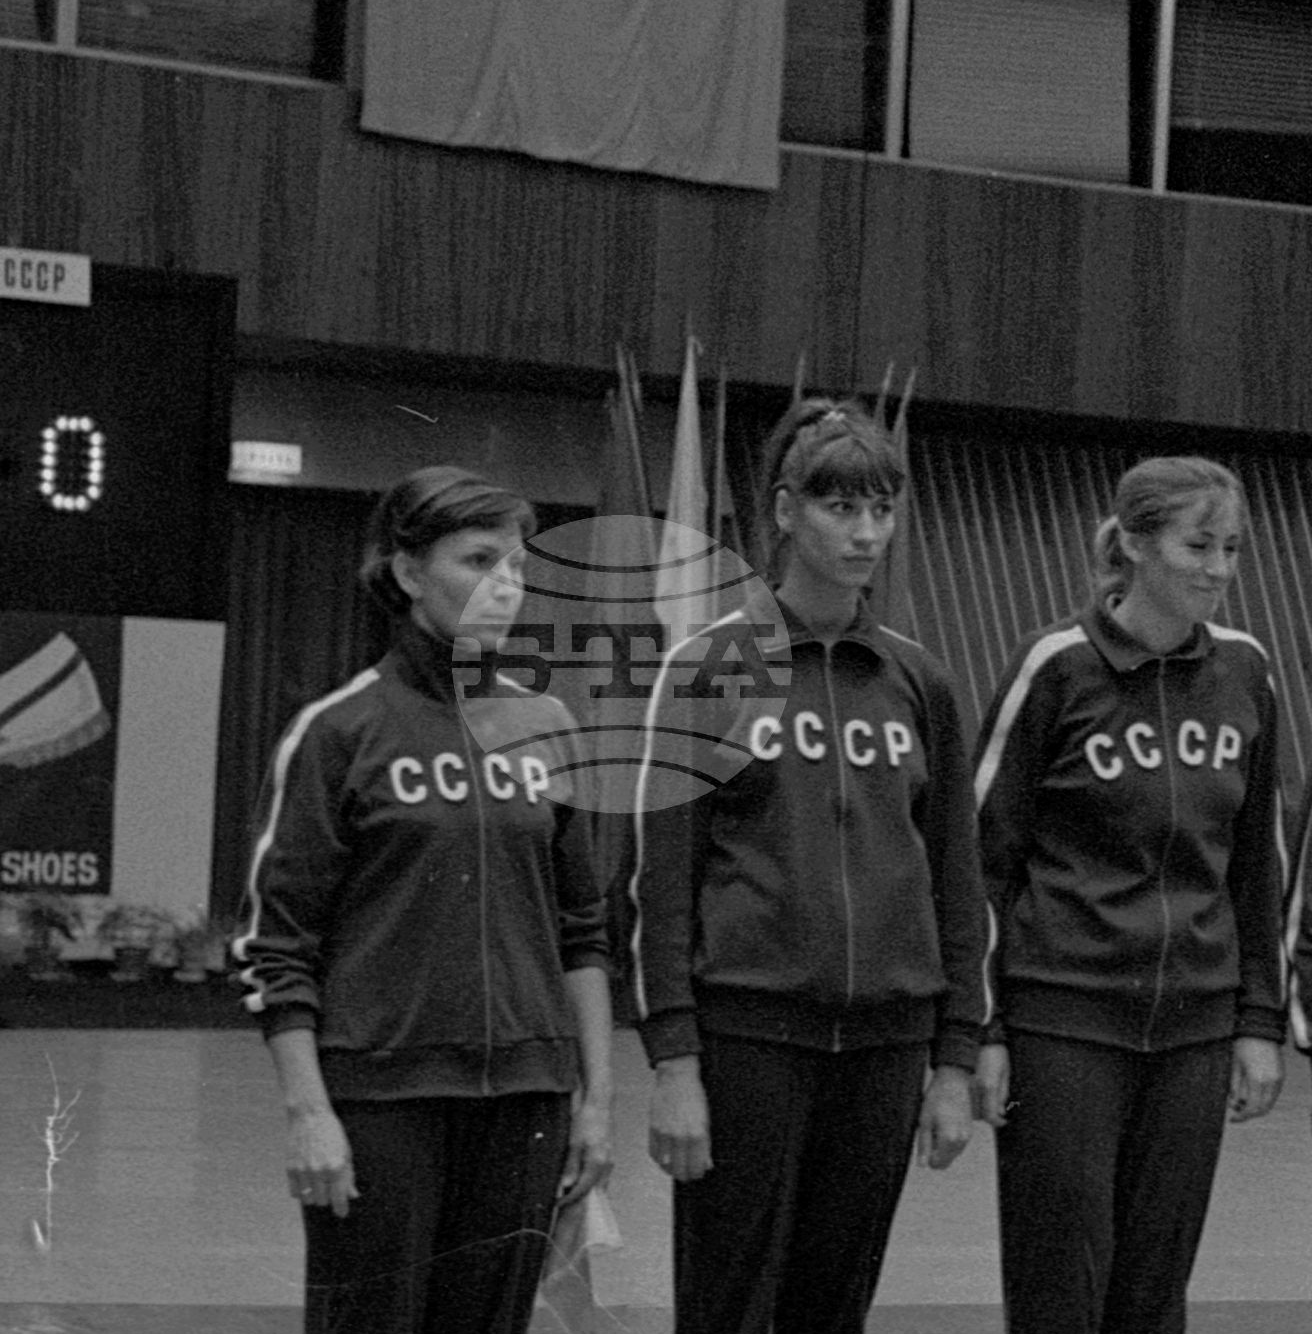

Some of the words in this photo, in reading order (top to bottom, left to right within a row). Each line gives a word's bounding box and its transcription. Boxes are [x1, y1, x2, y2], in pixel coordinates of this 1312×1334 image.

[4, 258, 66, 294] СССР
[40, 416, 105, 512] 0
[750, 711, 912, 766] СССР
[1085, 720, 1241, 781] СССР
[391, 753, 549, 804] СССР
[1, 850, 99, 886] SHOES
